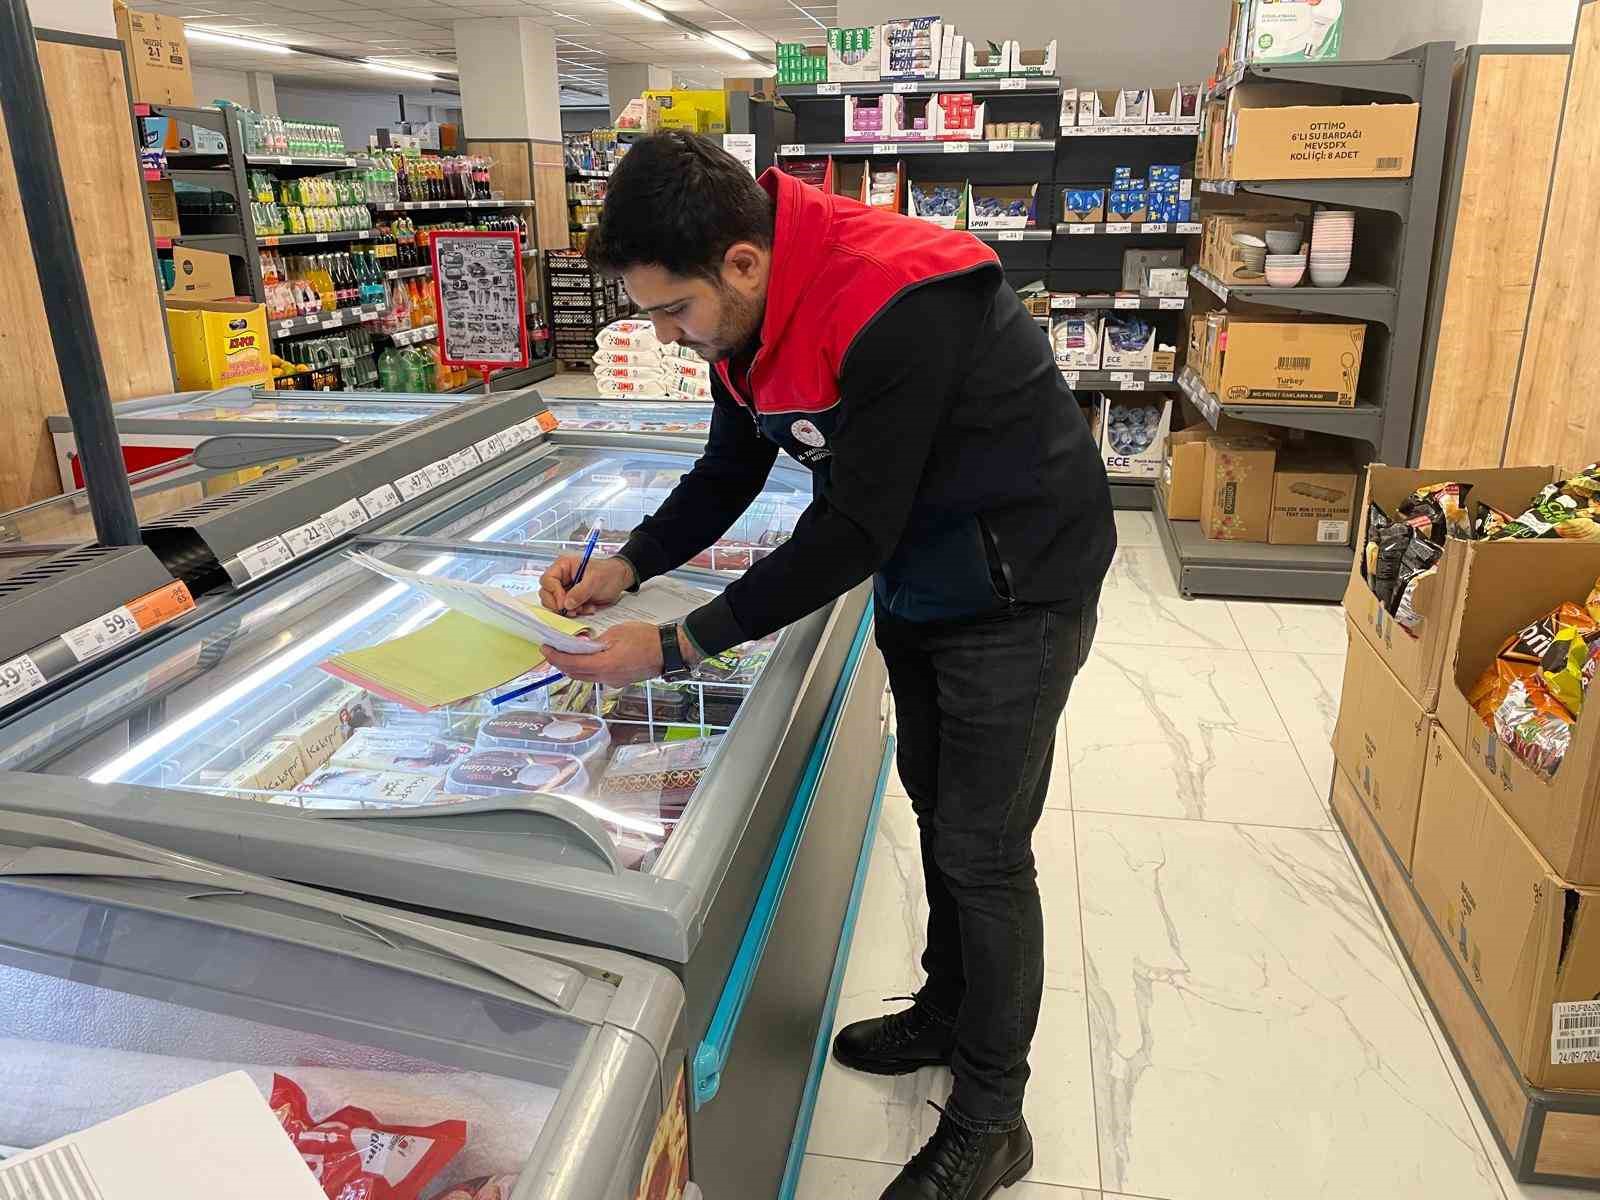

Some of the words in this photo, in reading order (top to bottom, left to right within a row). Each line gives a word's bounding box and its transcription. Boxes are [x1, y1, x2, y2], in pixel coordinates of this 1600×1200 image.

[1310, 120, 1346, 131] OTTİMO
[1308, 132, 1321, 141] SU
[1322, 129, 1362, 140] BARDAĞI
[1334, 151, 1360, 160] ADET
[1277, 376, 1305, 386] Turkey
[1107, 456, 1130, 467] ECE
[303, 525, 321, 541] 21
[103, 614, 126, 635] 59
[488, 719, 545, 732] Selection
[459, 763, 519, 778] Selection
